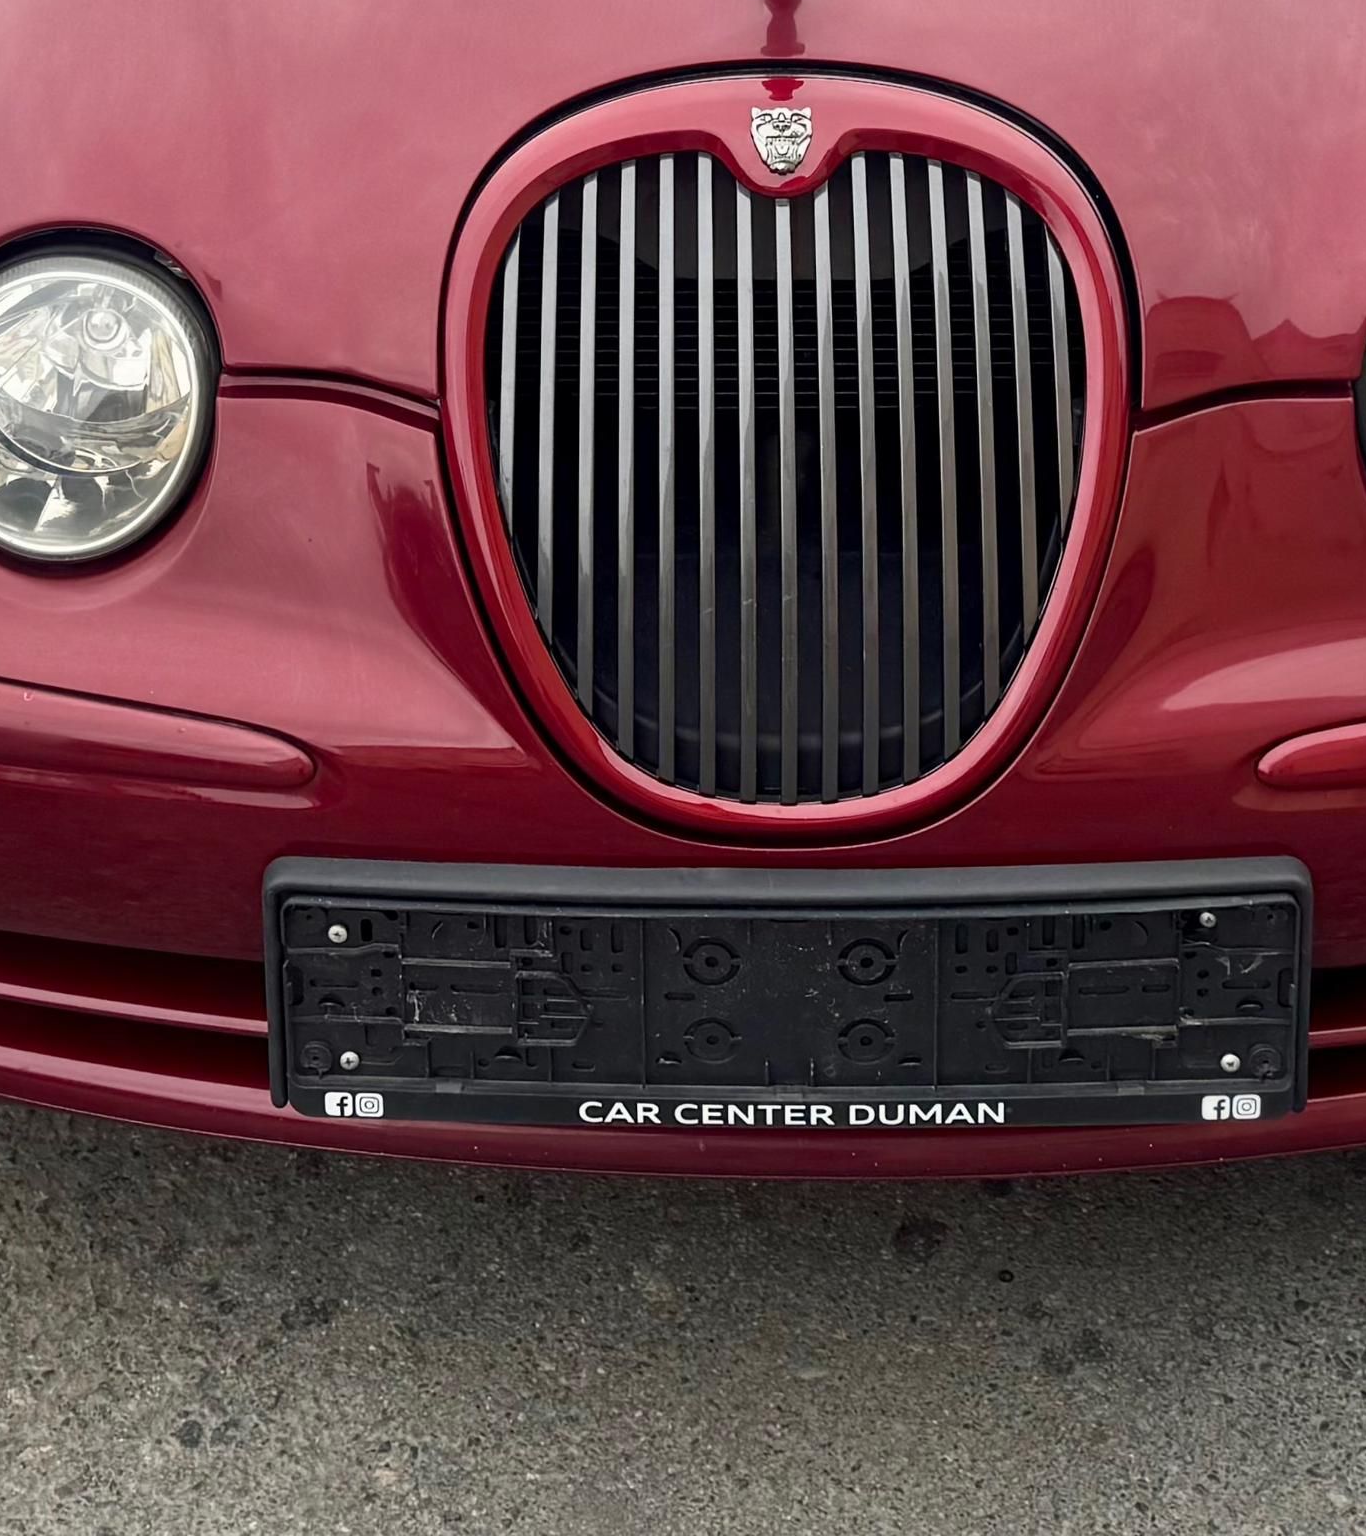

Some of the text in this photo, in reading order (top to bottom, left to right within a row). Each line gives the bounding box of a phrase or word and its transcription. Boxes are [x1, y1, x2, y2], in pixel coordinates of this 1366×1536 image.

[578, 1100, 662, 1125] CAR
[674, 1102, 836, 1126] CENTER
[848, 1101, 1006, 1125] DUMAN
